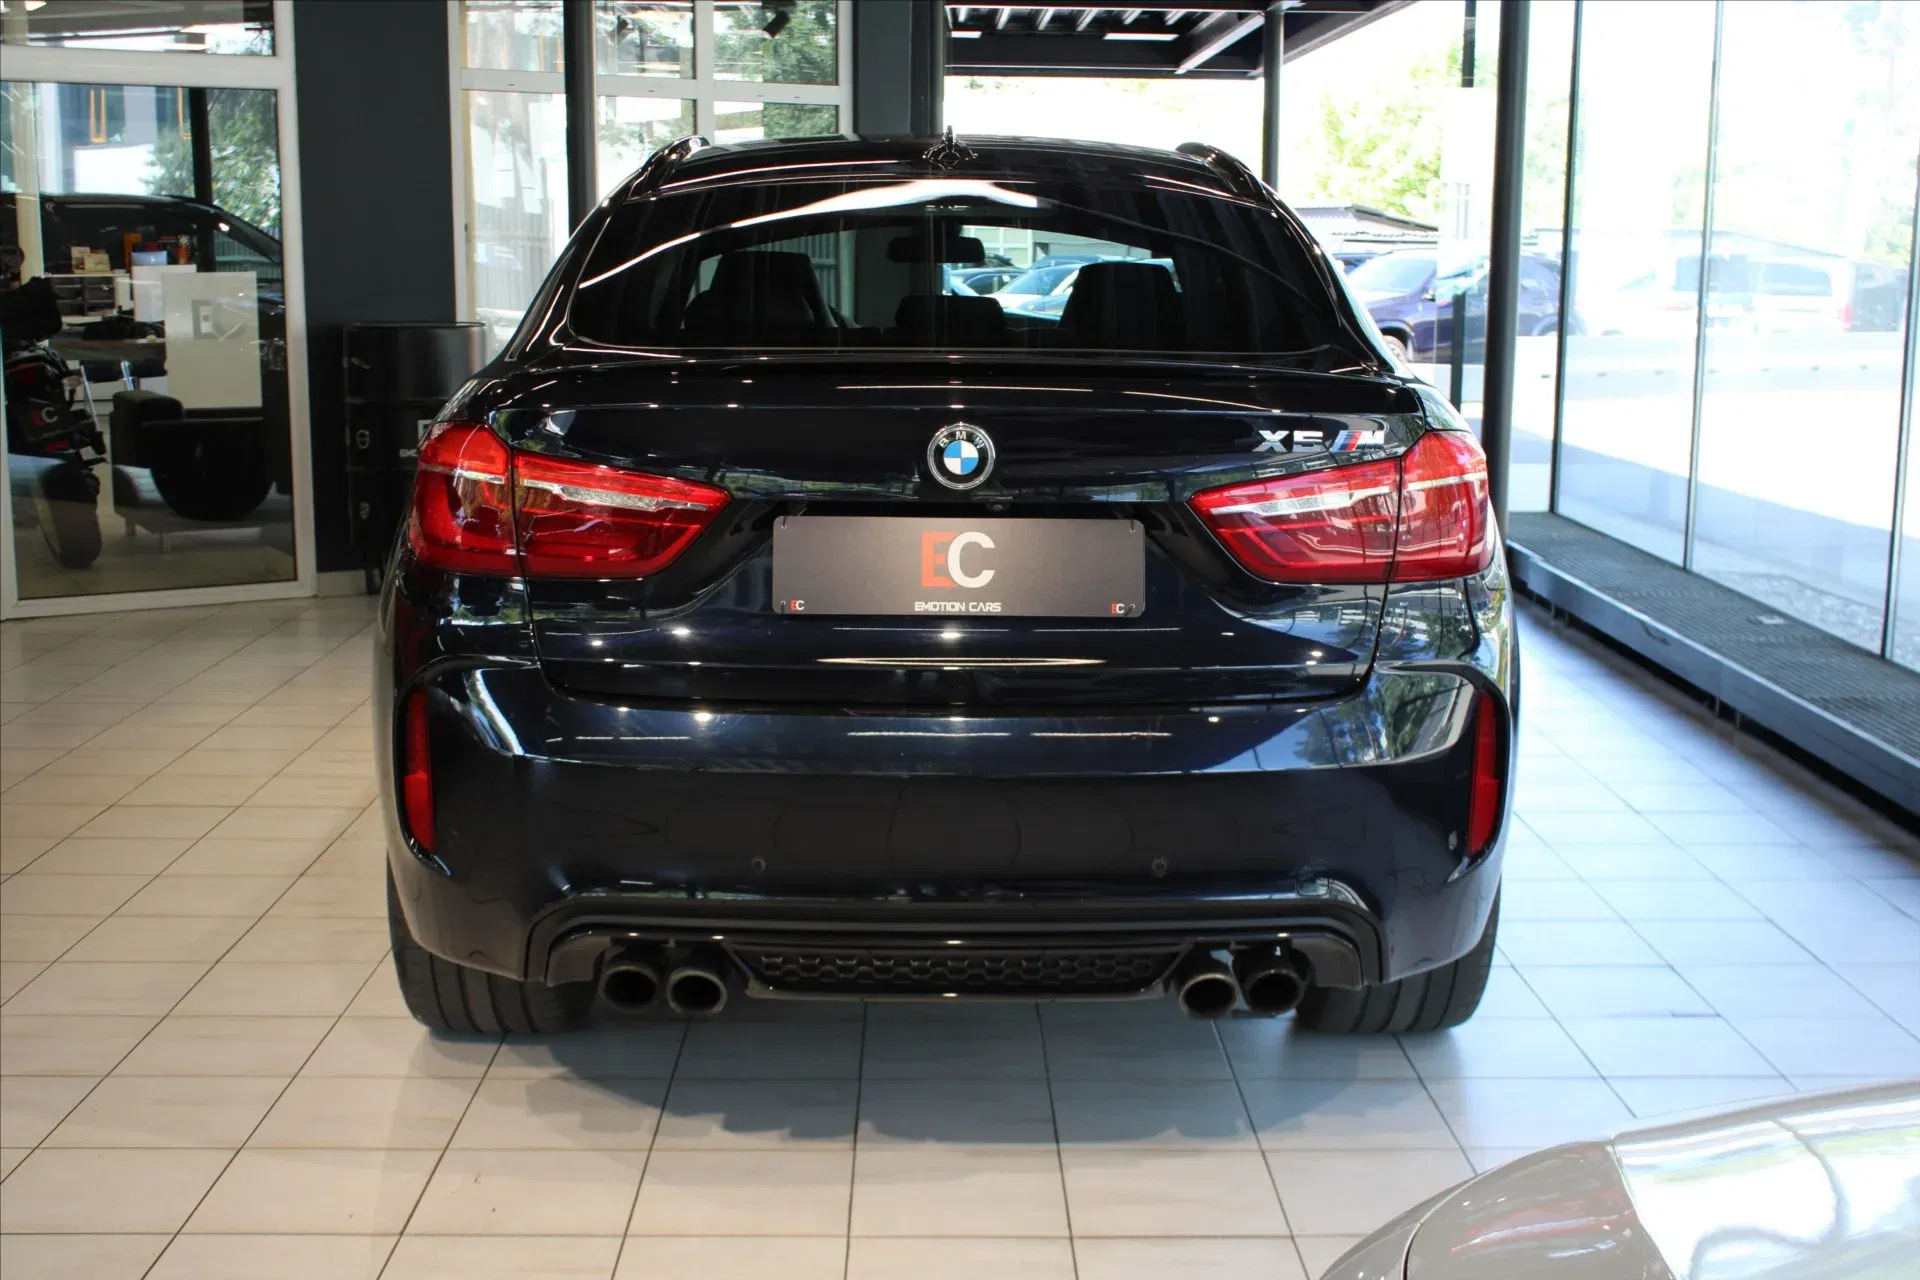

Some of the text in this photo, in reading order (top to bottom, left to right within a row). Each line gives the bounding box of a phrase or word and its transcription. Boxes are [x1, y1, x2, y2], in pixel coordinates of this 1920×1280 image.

[938, 430, 986, 449] BMW
[921, 531, 996, 589] EC
[914, 601, 1002, 613] EMOTION CARS
